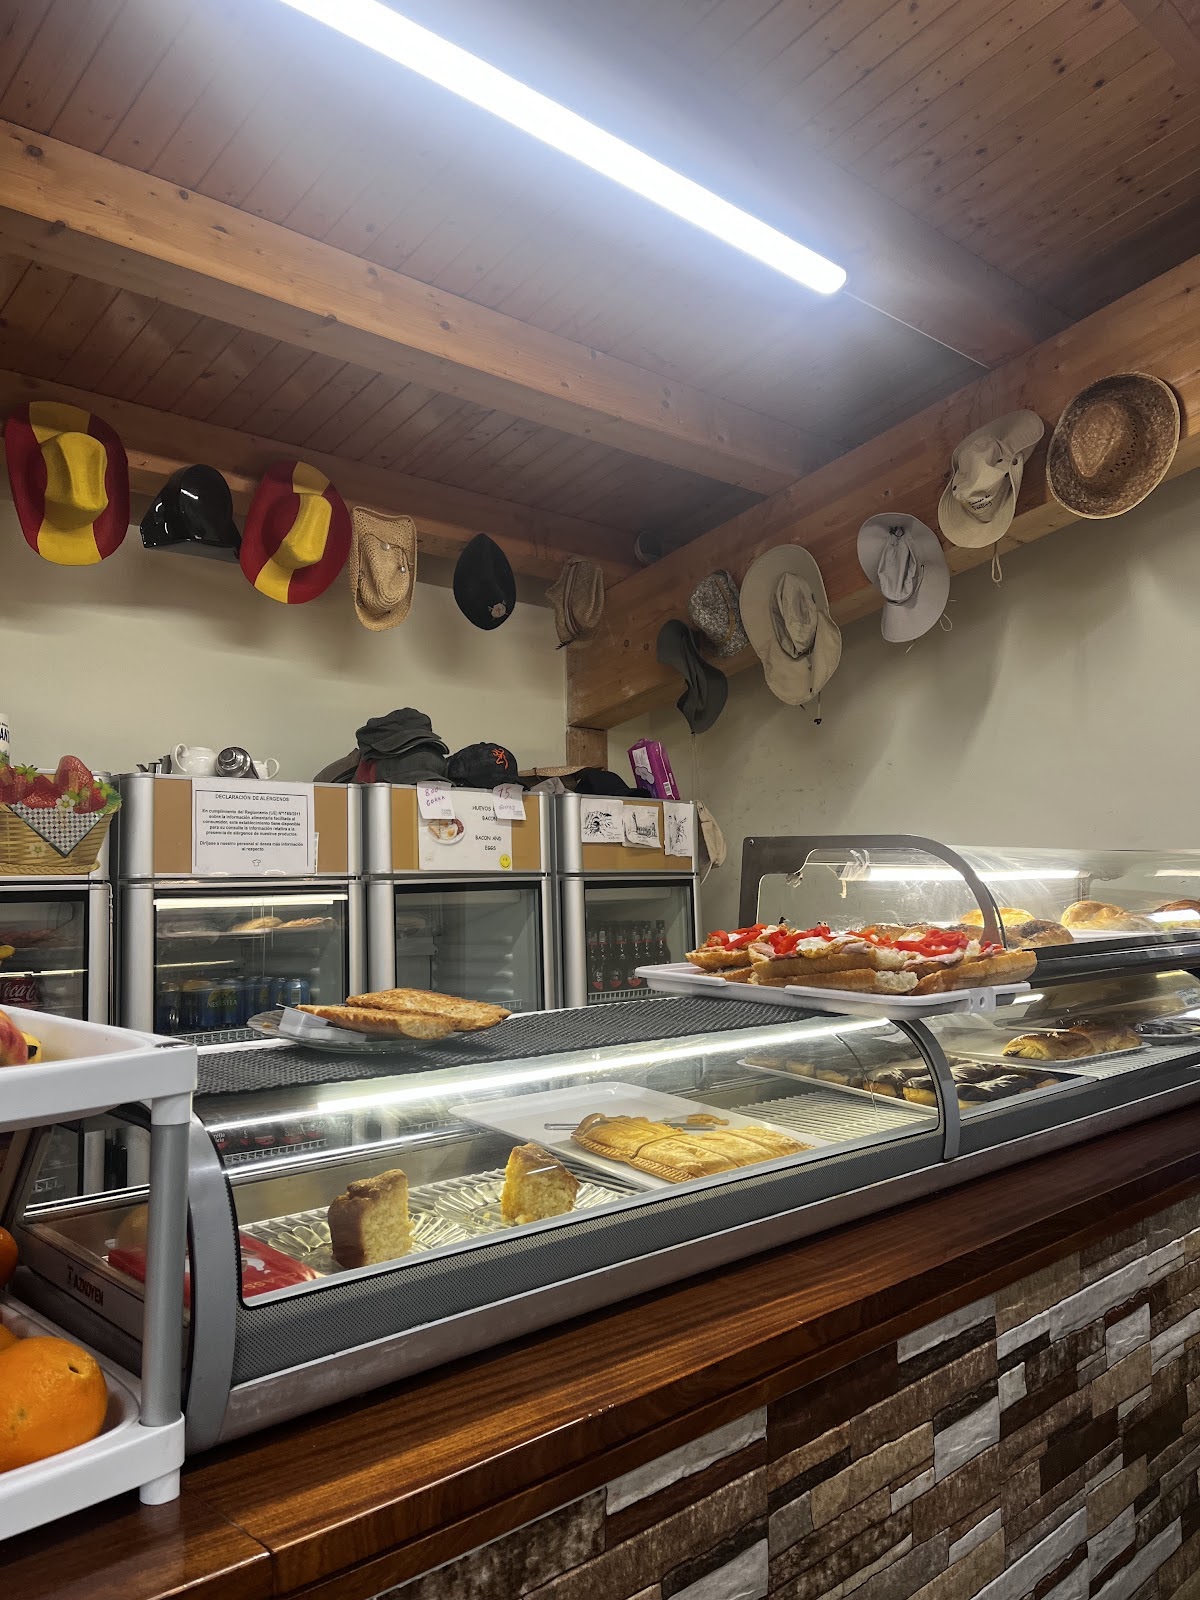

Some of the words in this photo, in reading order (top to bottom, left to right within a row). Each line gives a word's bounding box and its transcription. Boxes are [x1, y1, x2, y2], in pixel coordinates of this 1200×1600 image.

[472, 804, 492, 812] HUEVOS
[3, 980, 37, 1001] Coca-C
[74, 1275, 104, 1307] AZKOYEN
